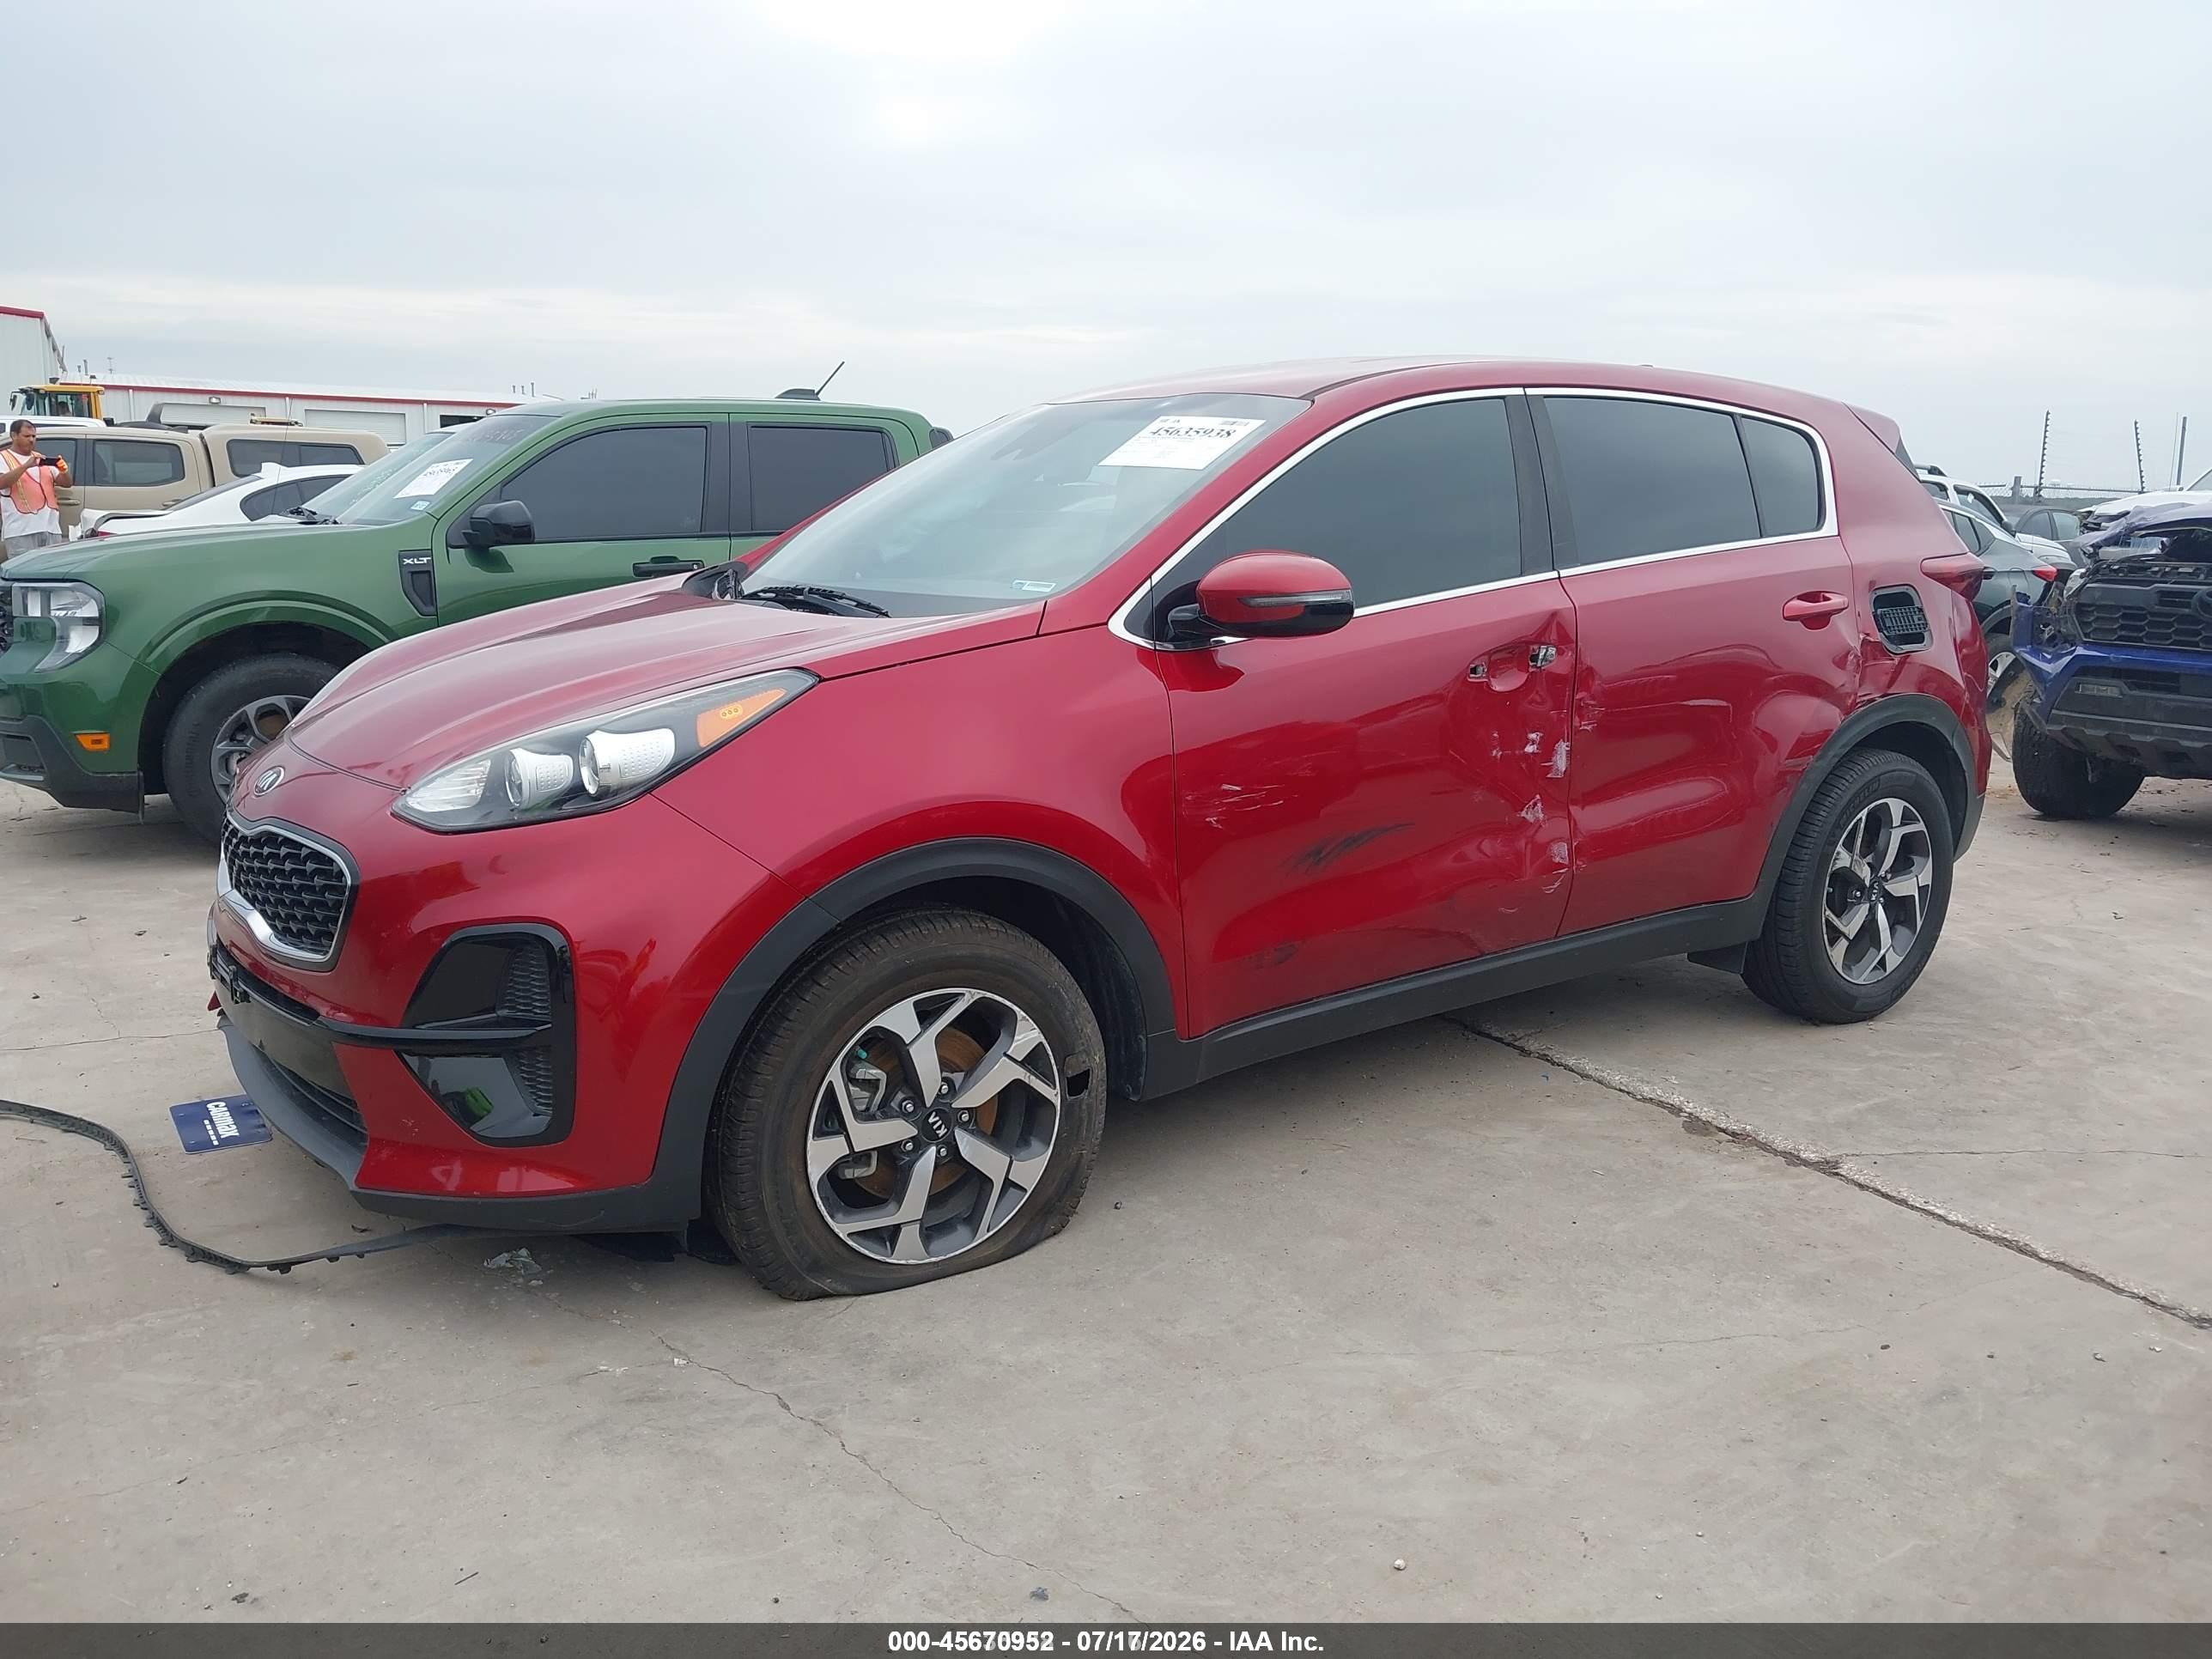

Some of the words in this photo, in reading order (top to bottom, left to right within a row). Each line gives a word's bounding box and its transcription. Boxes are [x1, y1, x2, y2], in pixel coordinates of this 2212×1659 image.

[1150, 426, 1237, 439] 45635938
[403, 556, 431, 565] XLT
[1870, 882, 1879, 900] KIA
[927, 1111, 948, 1138] KIA
